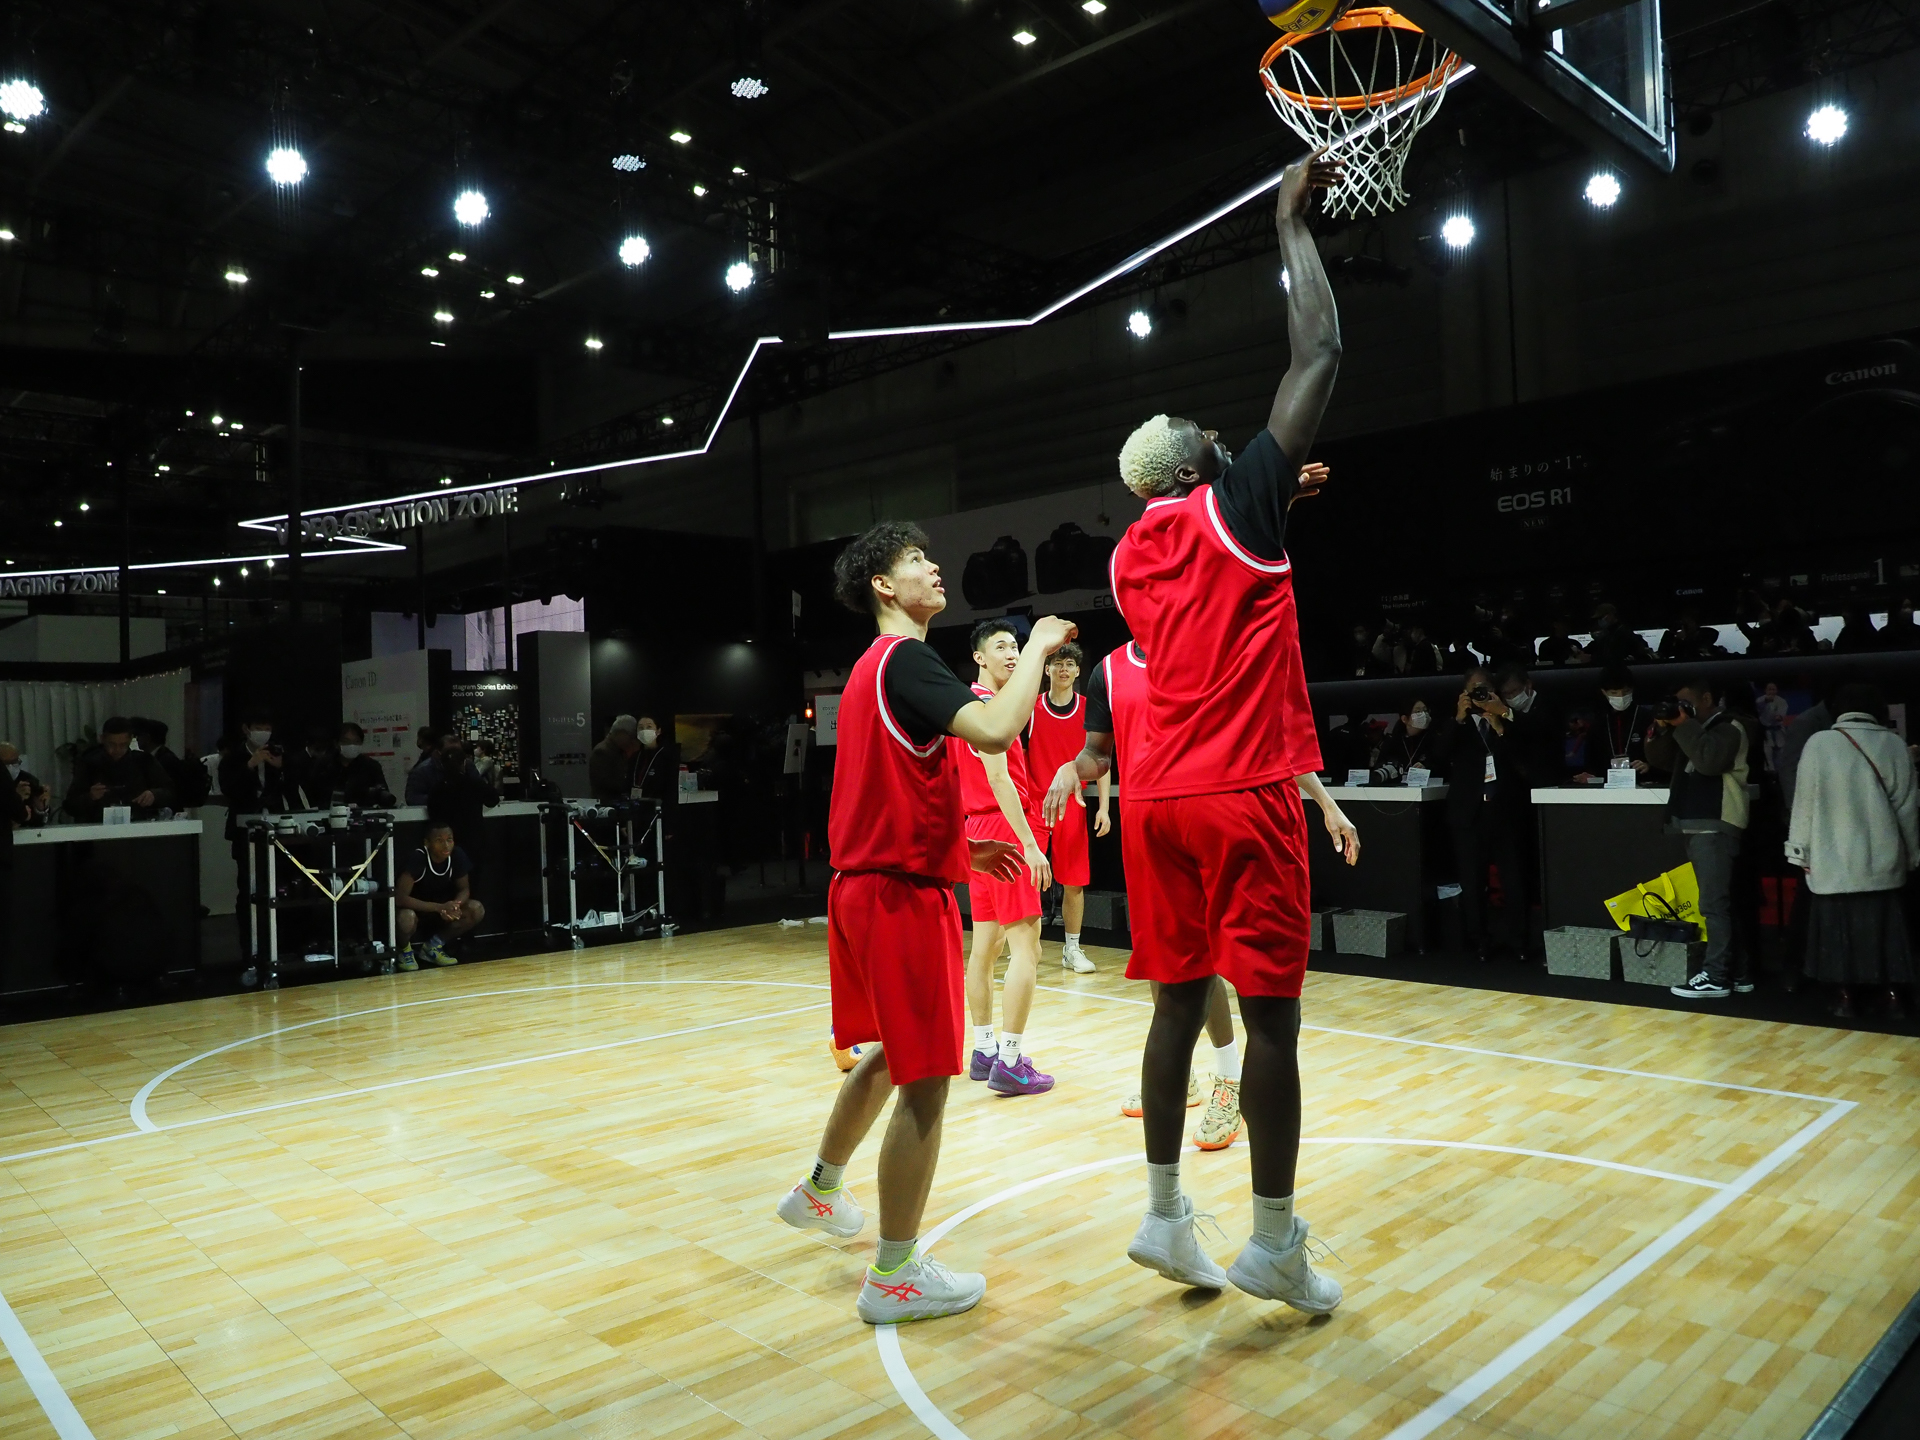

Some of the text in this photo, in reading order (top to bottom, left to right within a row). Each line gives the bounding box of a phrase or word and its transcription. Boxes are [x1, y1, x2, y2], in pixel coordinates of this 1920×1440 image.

[1825, 363, 1897, 385] Canon
[1497, 487, 1571, 513] EOS R1
[275, 486, 518, 545] VDEO CREATION ZONE
[1523, 519, 1546, 528] NEW
[69, 572, 119, 593] ZONE
[1675, 588, 1703, 596] Canon
[345, 672, 377, 690] Canon ID
[477, 683, 496, 691] Stories
[576, 712, 586, 727] 5
